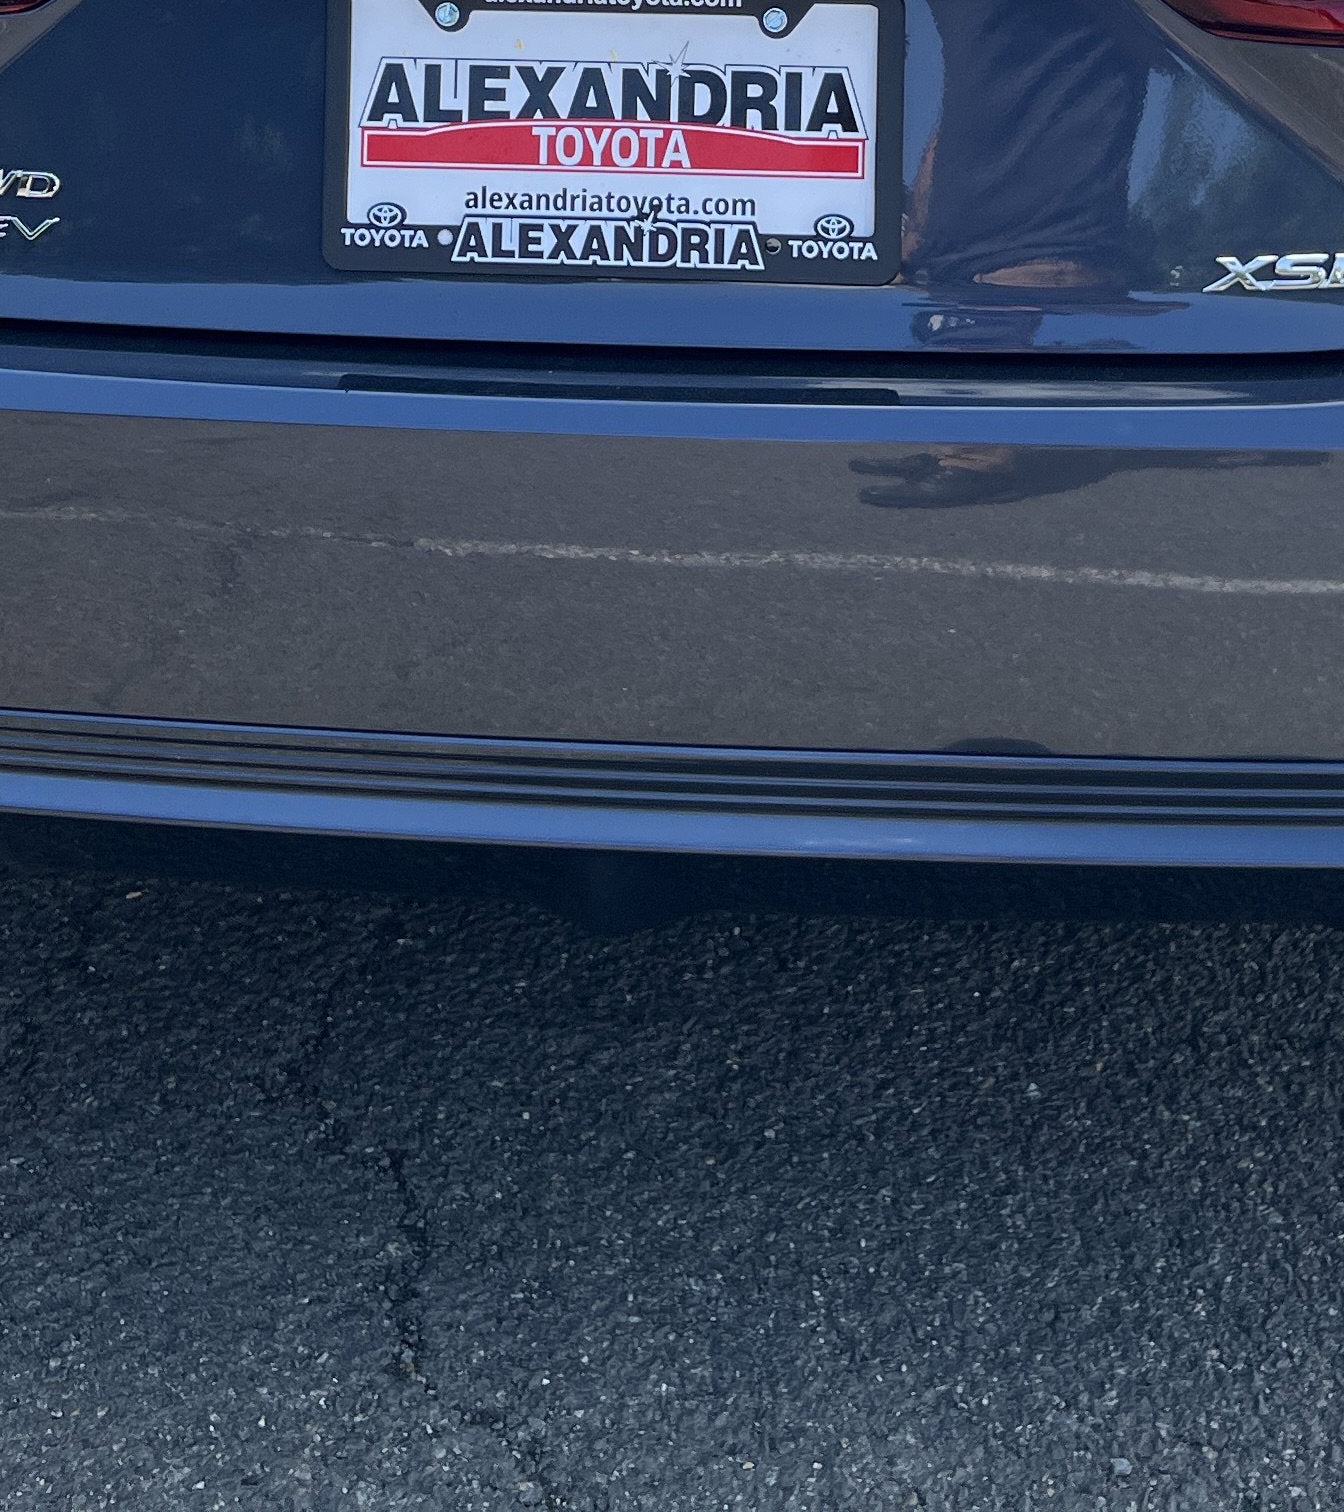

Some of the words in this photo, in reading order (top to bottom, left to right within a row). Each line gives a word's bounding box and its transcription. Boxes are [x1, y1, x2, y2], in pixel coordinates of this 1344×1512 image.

[363, 59, 863, 136] ALEXANDRIA
[531, 125, 692, 170] TOYOTA
[464, 185, 757, 217] alexandriatoyota.com
[340, 227, 429, 249] TOYOTA
[453, 217, 762, 268] ALEXANDRIA
[787, 239, 878, 261] TOYOTA
